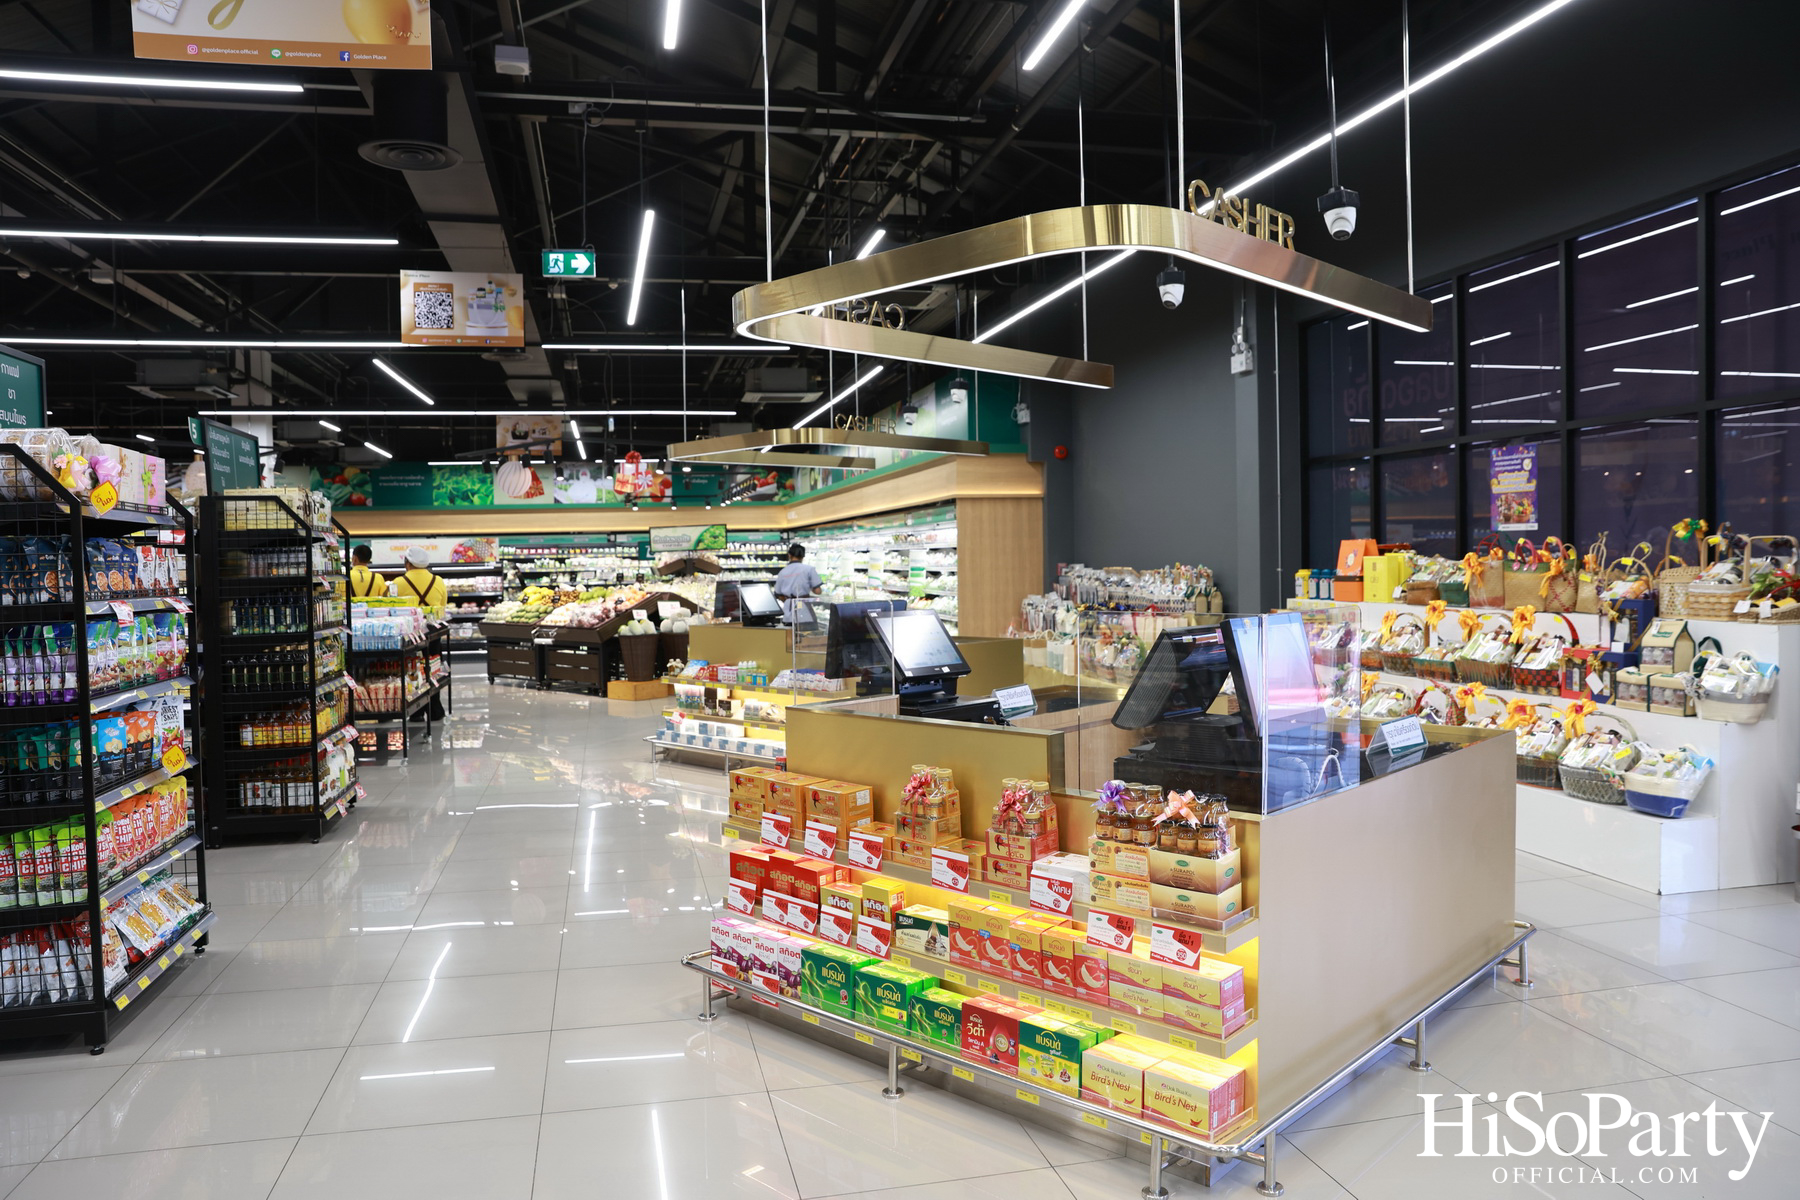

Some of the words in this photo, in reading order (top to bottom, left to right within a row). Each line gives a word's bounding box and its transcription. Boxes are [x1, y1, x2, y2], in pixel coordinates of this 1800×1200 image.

[284, 51, 322, 59] @goldenplace
[1187, 178, 1297, 251] CASHIER
[0, 362, 20, 379] กาแฟ
[191, 422, 198, 440] 5
[834, 413, 897, 435] CASHIER
[1051, 883, 1072, 896] พิเศษ
[821, 966, 846, 984] แบรนด์
[876, 987, 901, 1003] แบรนด์
[933, 1008, 955, 1024] แบรนด์
[966, 1022, 985, 1038] วีต้า
[1035, 1033, 1061, 1051] แบรนด์
[1090, 1071, 1111, 1086] Bird's
[1112, 1079, 1131, 1093] Nest
[1154, 1090, 1177, 1107] Bird's
[1178, 1098, 1198, 1113] Nest
